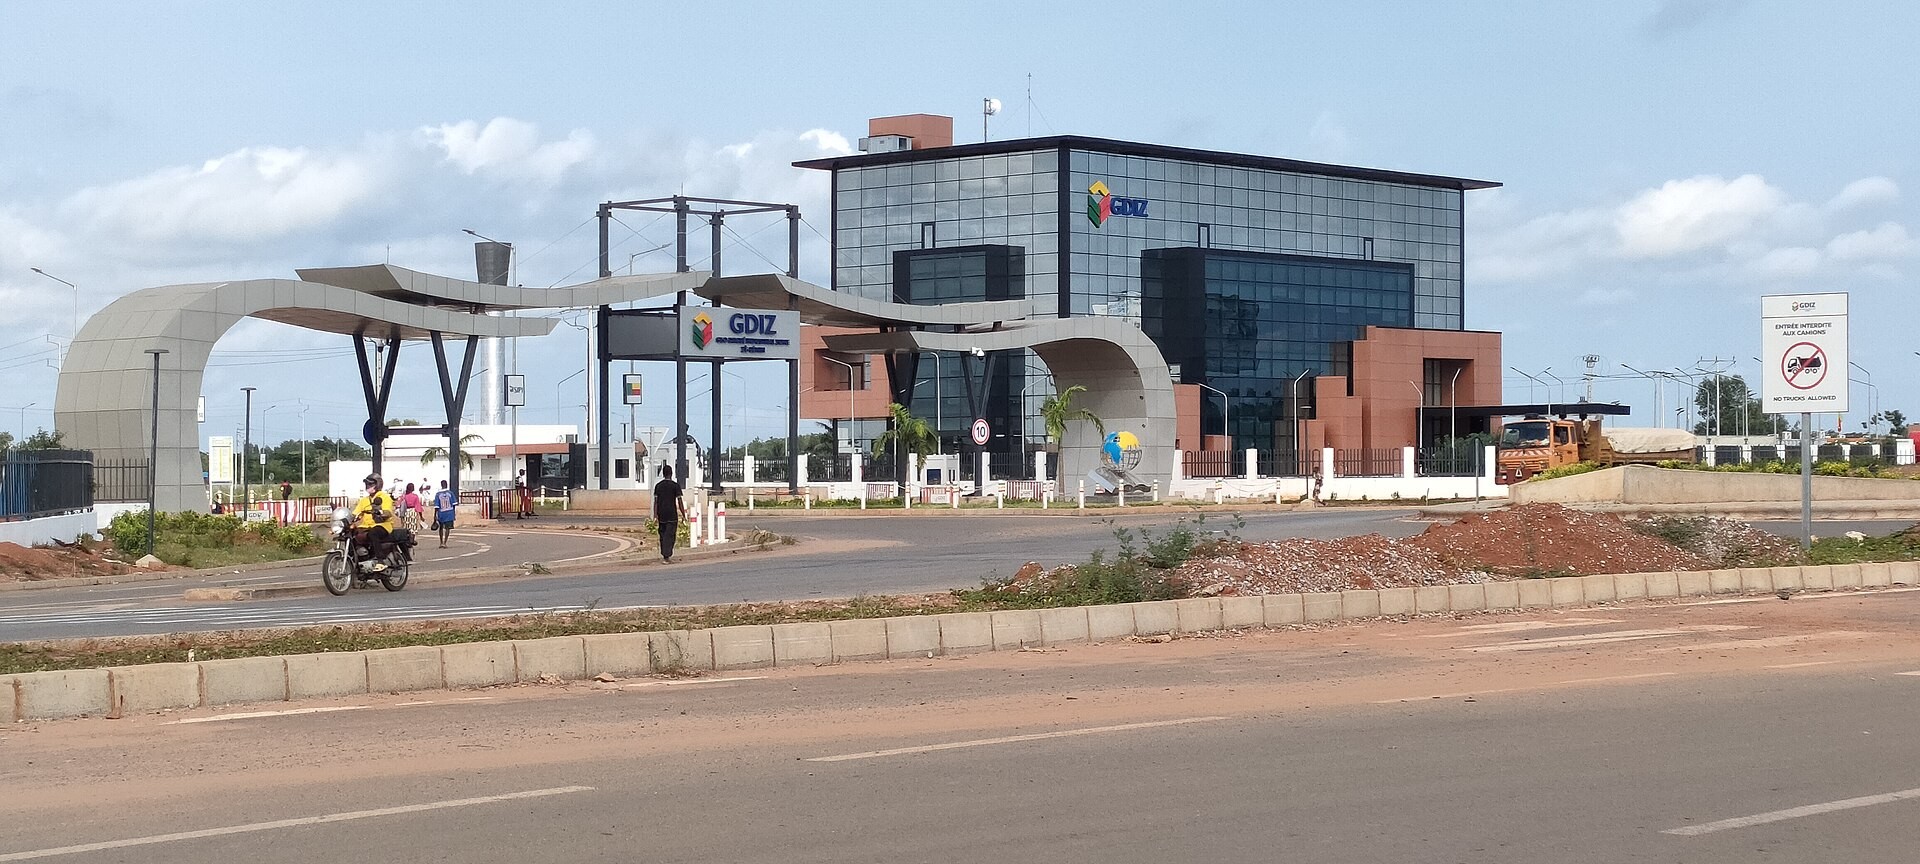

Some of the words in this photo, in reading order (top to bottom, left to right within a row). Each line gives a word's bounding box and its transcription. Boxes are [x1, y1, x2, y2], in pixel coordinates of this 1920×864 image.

[1110, 198, 1149, 217] GDIZ
[729, 313, 777, 335] GDIZ
[976, 426, 986, 438] 10
